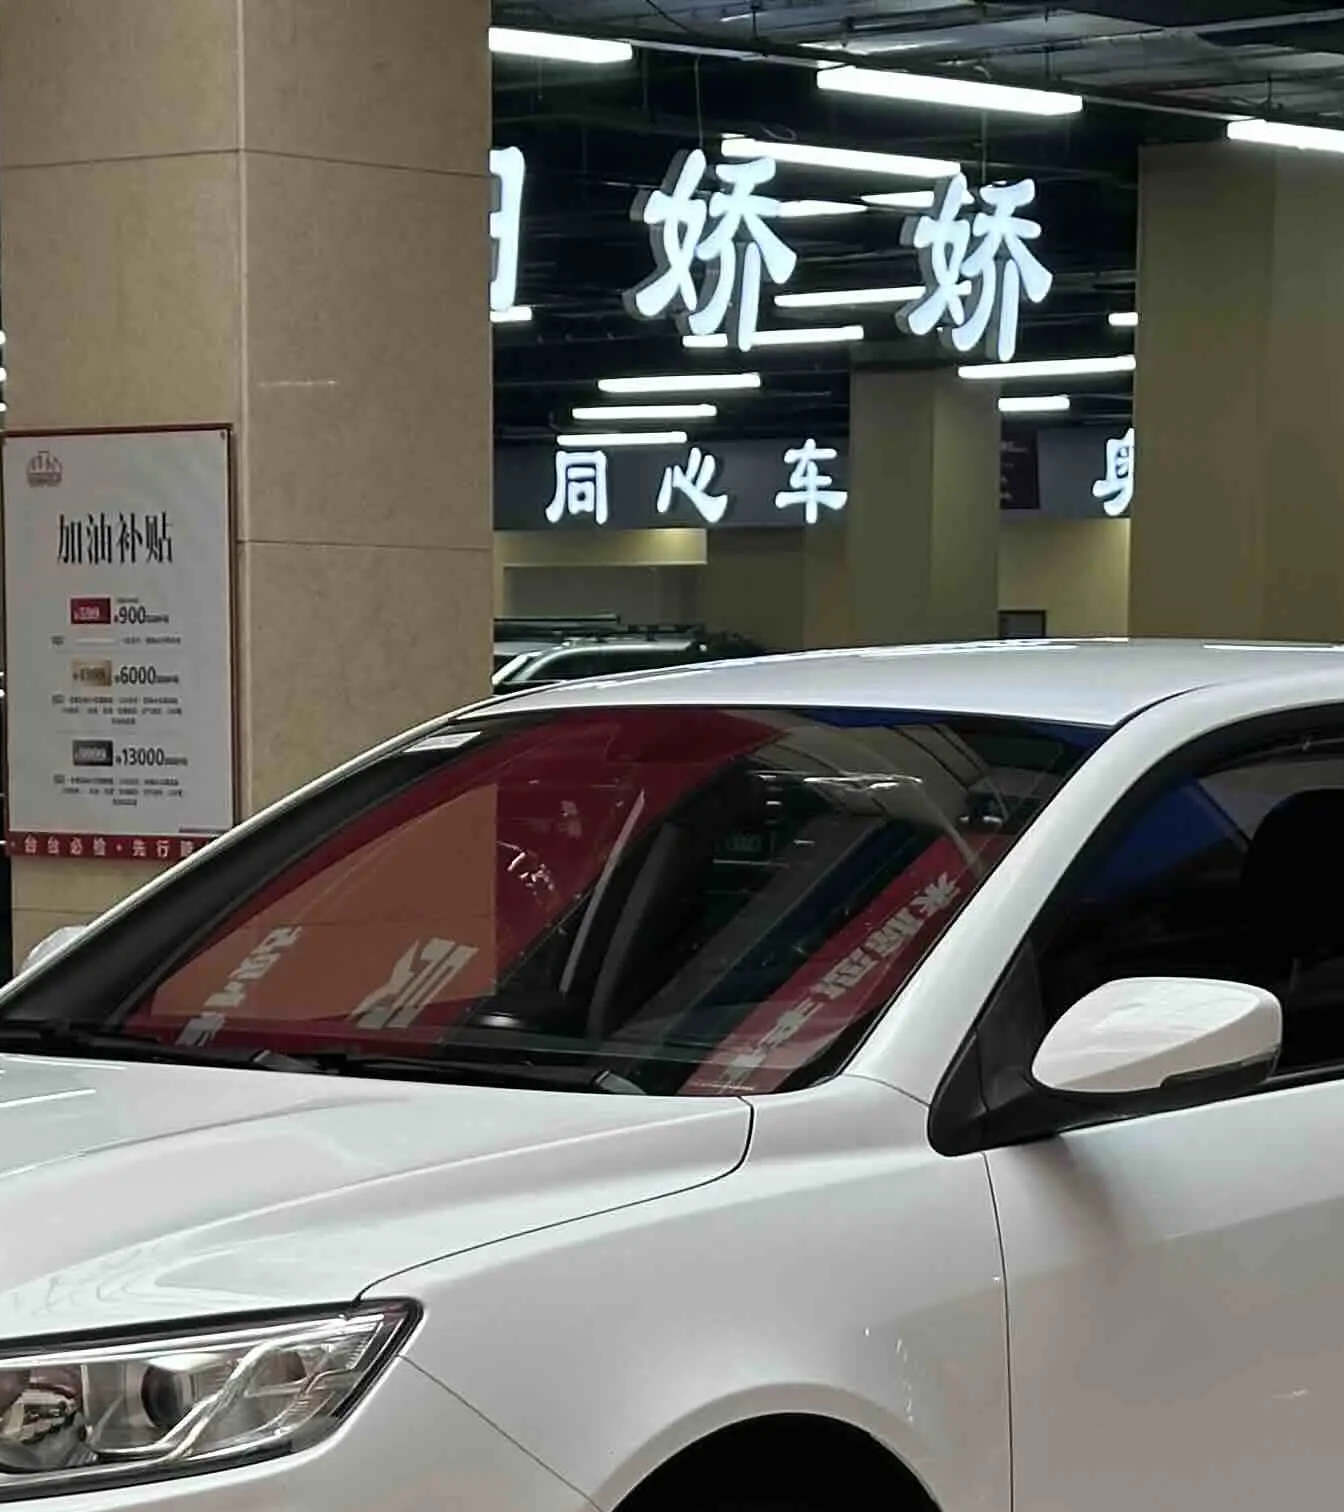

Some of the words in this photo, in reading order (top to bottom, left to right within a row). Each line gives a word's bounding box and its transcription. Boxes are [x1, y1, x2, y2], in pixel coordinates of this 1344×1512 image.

[545, 437, 849, 525] 同心车
[56, 510, 174, 565] 加油补贴
